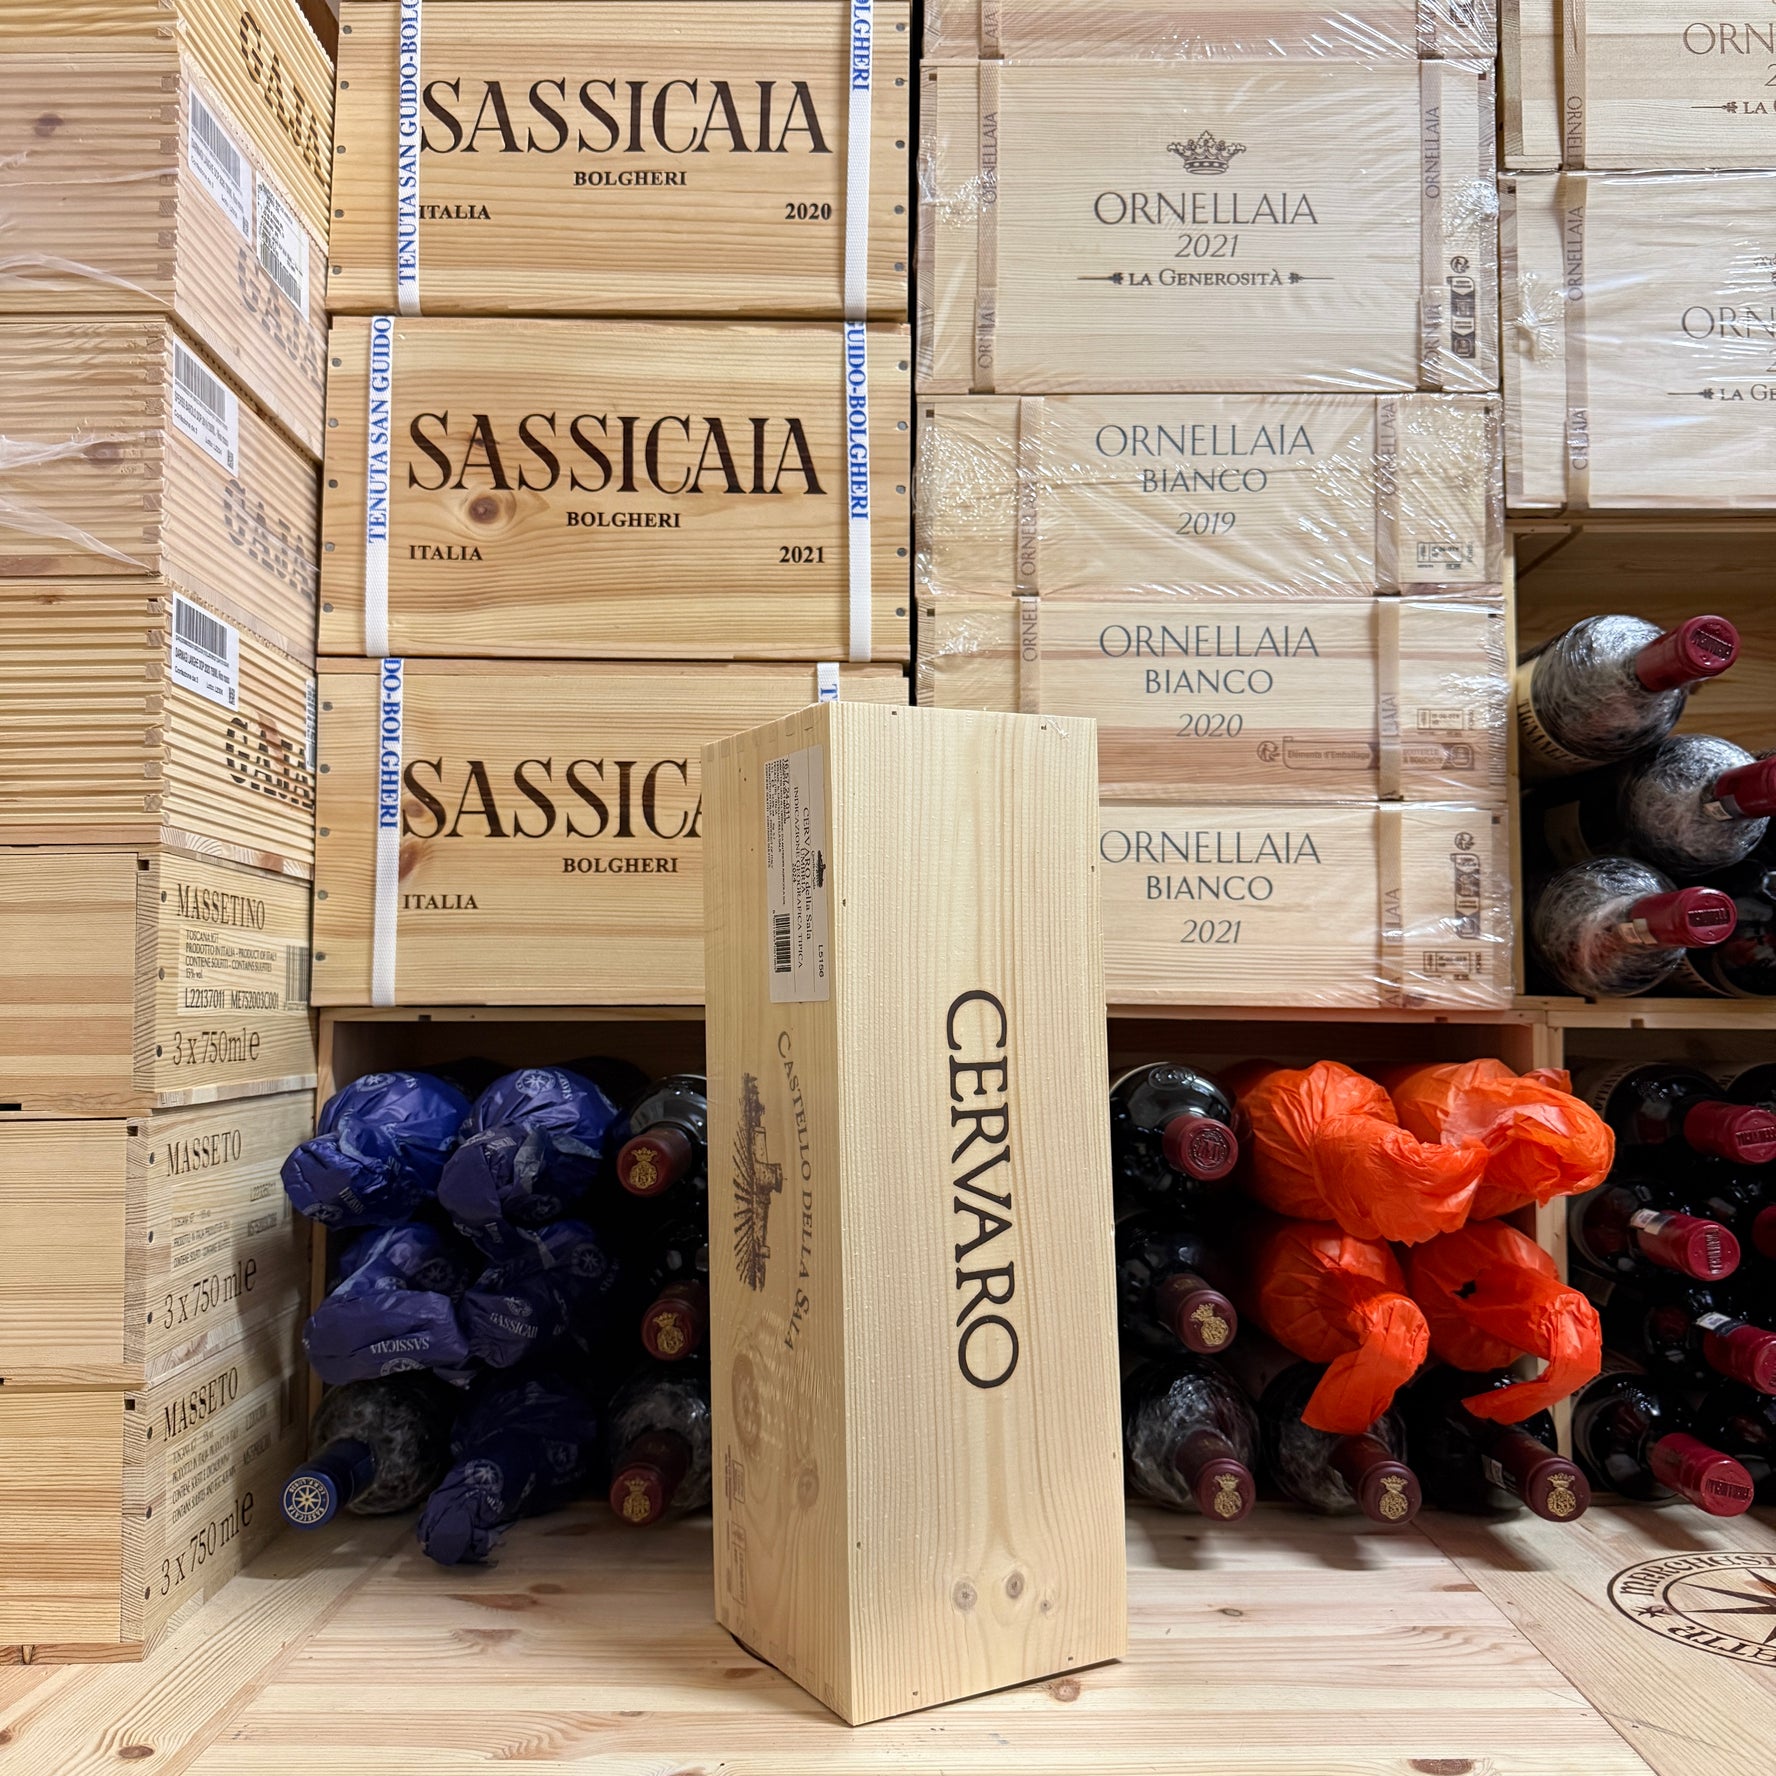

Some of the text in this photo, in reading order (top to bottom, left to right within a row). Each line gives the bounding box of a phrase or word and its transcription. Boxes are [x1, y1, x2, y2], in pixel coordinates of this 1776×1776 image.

[420, 76, 834, 155] SASSICAIA
[399, 144, 418, 187] SAN
[1424, 105, 1441, 198] ORNELLAIA
[573, 170, 688, 187] BOLGHERI
[418, 202, 833, 221] ITALIA 2020
[1093, 192, 1319, 226] ORNELLAIA
[398, 193, 418, 285] TENUTA
[1174, 234, 1239, 259] 2021
[1568, 205, 1585, 301] ORNELLAIA
[1129, 273, 1154, 287] LA
[368, 318, 392, 544] TENUTA SAN GUIDO
[1094, 424, 1316, 458] ORNELLAIA
[407, 410, 829, 496] SASSICAIA
[1141, 467, 1269, 494] BIANCO
[566, 511, 682, 529] BOLGHERI
[1175, 511, 1237, 536] 2019
[408, 545, 826, 565] ITALIA 2021
[1099, 625, 1321, 658] ORNELLAIA
[1144, 668, 1274, 695] BIANCO
[1176, 713, 1244, 738] 2020
[402, 757, 702, 840] SASSIC
[801, 806, 812, 879] CERVARO
[1100, 830, 1321, 866] ORNELLAIA
[562, 856, 680, 874] BOLGHERI
[403, 893, 479, 911] ITALIA
[1145, 875, 1274, 901] BIANCO
[177, 883, 265, 930] MASSETINO
[804, 914, 814, 940] Sala
[1179, 919, 1242, 944] 2021
[185, 943, 214, 956] PRODOTTO
[185, 988, 225, 1009] L22137011
[173, 1031, 182, 1065] 3
[167, 1128, 242, 1178] MASSETO
[776, 1030, 813, 1181] CASTELLO
[798, 1190, 814, 1280] DELLA
[946, 989, 1019, 1390] CERVARO
[163, 1294, 174, 1330] 3
[368, 1336, 430, 1354] SASSICAIA
[163, 1366, 239, 1443] MASSETO
[287, 1502, 325, 1523] SASSICAIA
[160, 1559, 172, 1597] 3
